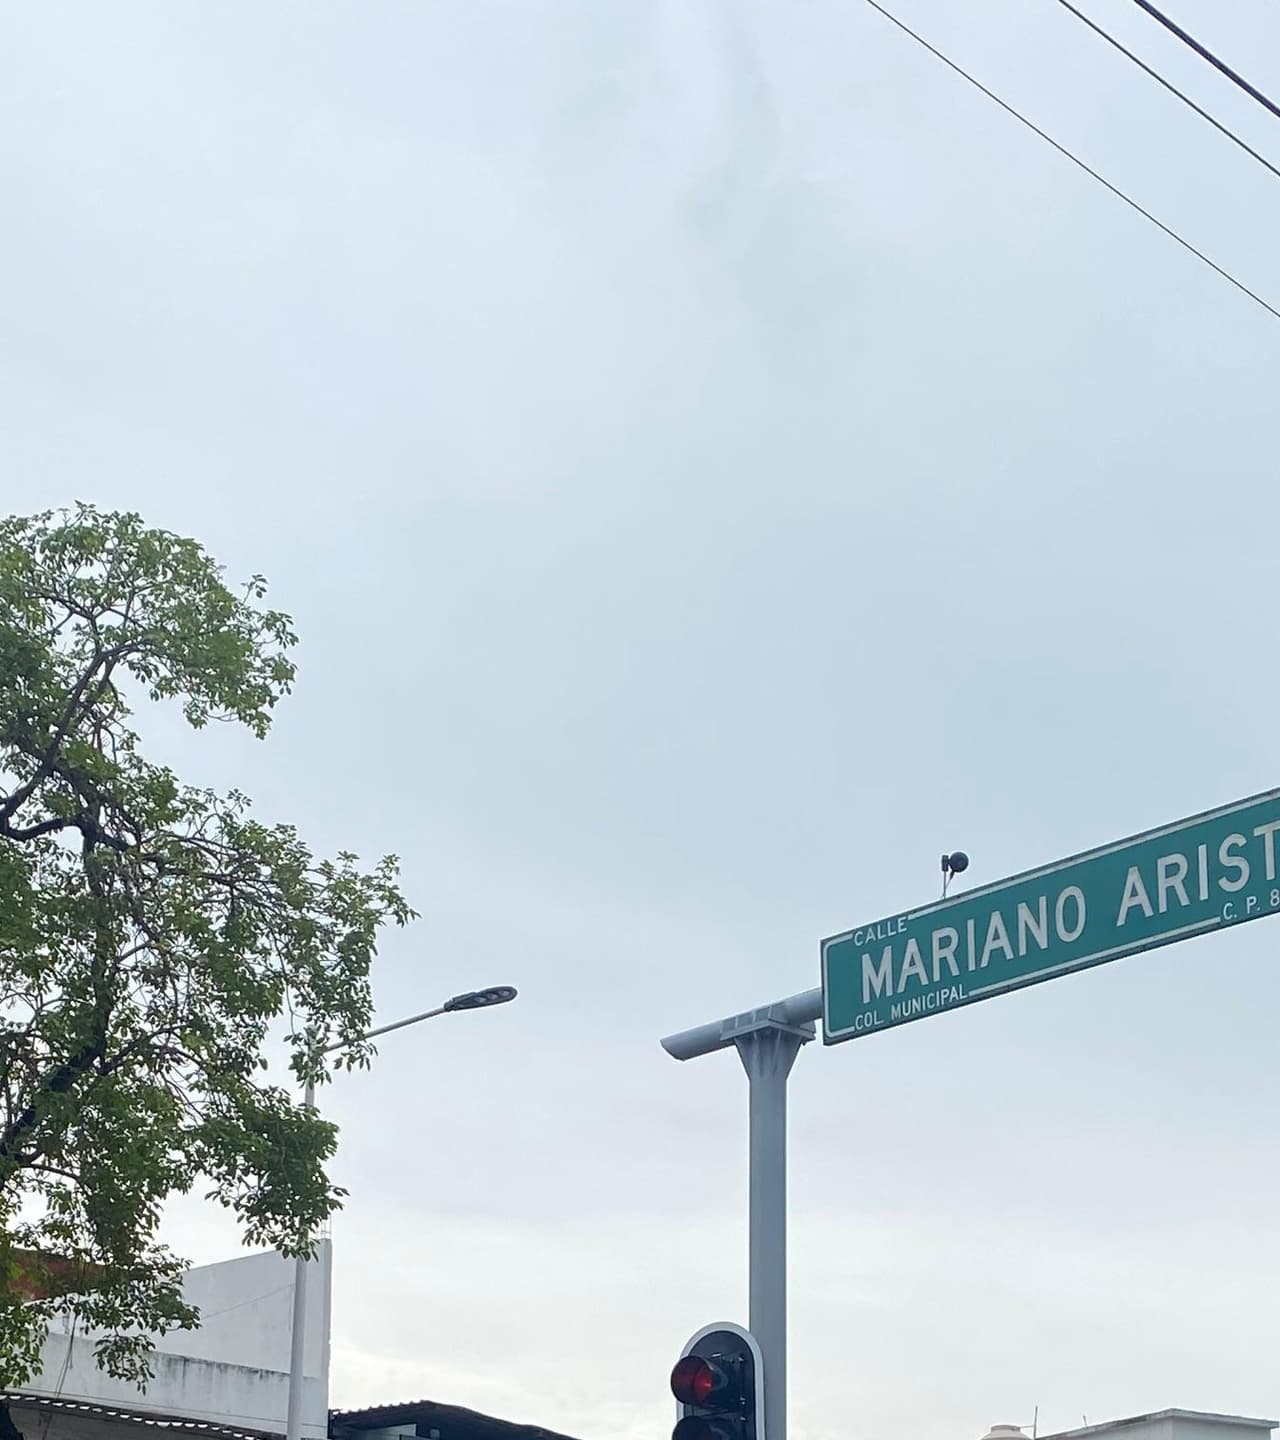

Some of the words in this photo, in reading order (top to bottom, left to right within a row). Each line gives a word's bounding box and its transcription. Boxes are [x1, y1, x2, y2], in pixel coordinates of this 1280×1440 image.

[1223, 902, 1238, 920] C.
[1245, 895, 1261, 915] P.
[853, 916, 908, 947] CALLE
[861, 885, 1087, 1005] MARIANO
[890, 983, 968, 1021] MUNICIPAL
